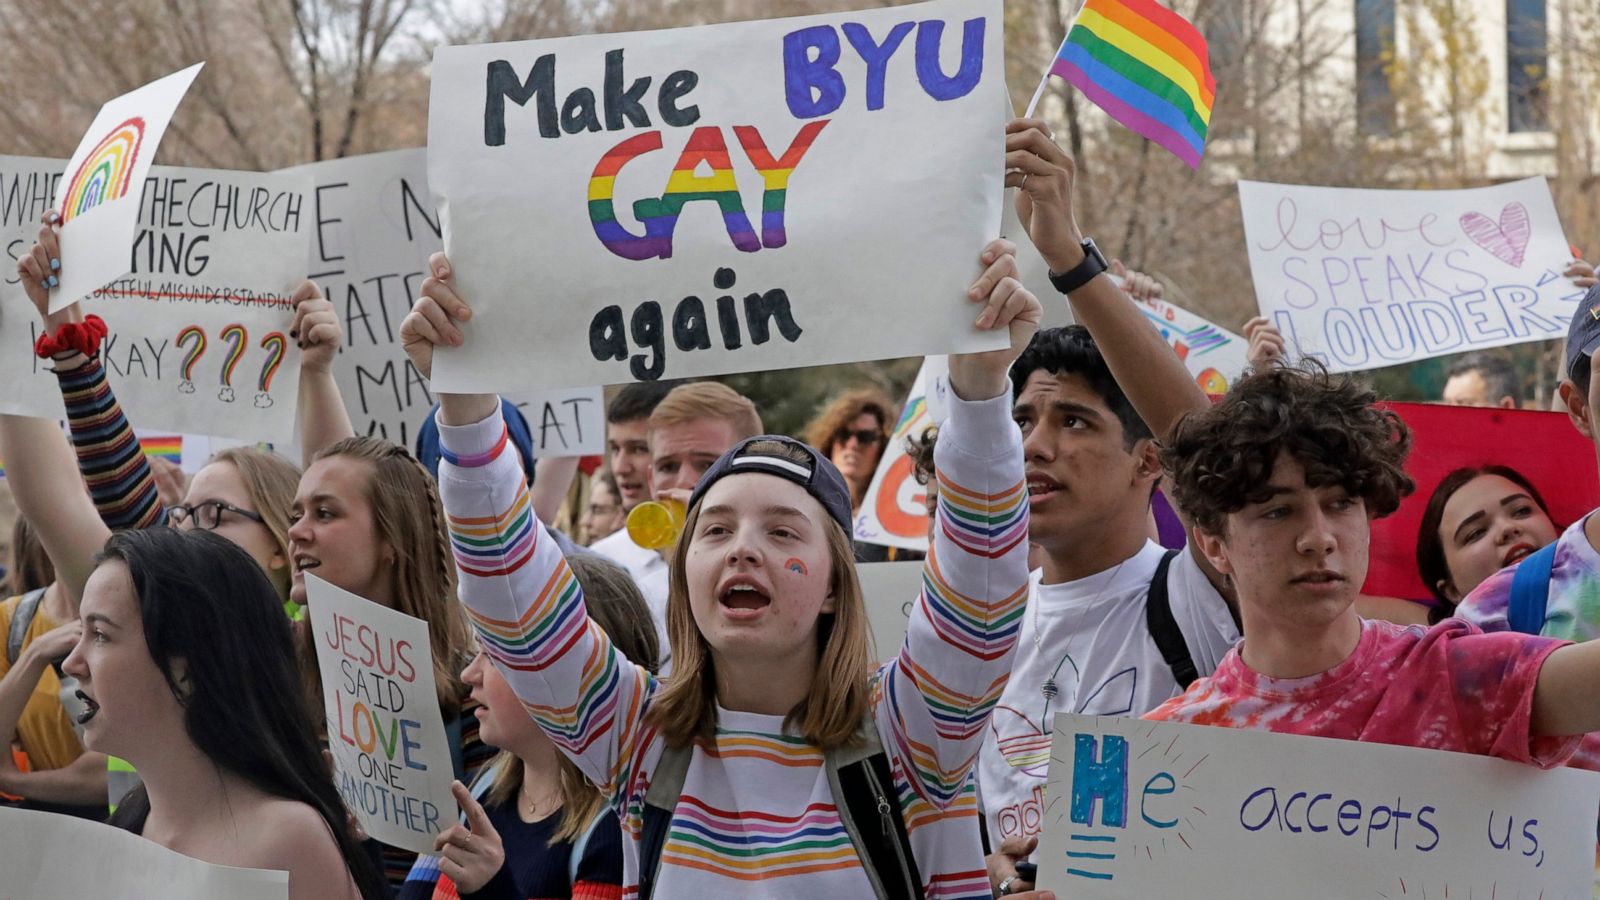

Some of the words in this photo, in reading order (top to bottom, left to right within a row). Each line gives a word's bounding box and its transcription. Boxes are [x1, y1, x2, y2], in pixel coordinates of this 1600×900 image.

[484, 48, 701, 146] Make
[783, 17, 986, 119] BYU
[588, 119, 831, 260] GAY
[1257, 197, 1457, 252] love
[1282, 250, 1489, 310] SPEAKS
[589, 267, 803, 381] again
[1274, 285, 1562, 370] LOUDER
[325, 612, 416, 683] JESUS
[340, 659, 405, 713] SAID
[335, 688, 427, 771] LOVE
[340, 770, 441, 834] ANOTHER
[358, 752, 406, 791] ONE
[1071, 733, 1179, 829] He
[1240, 786, 1440, 852] accepts
[1488, 809, 1545, 867] us,
